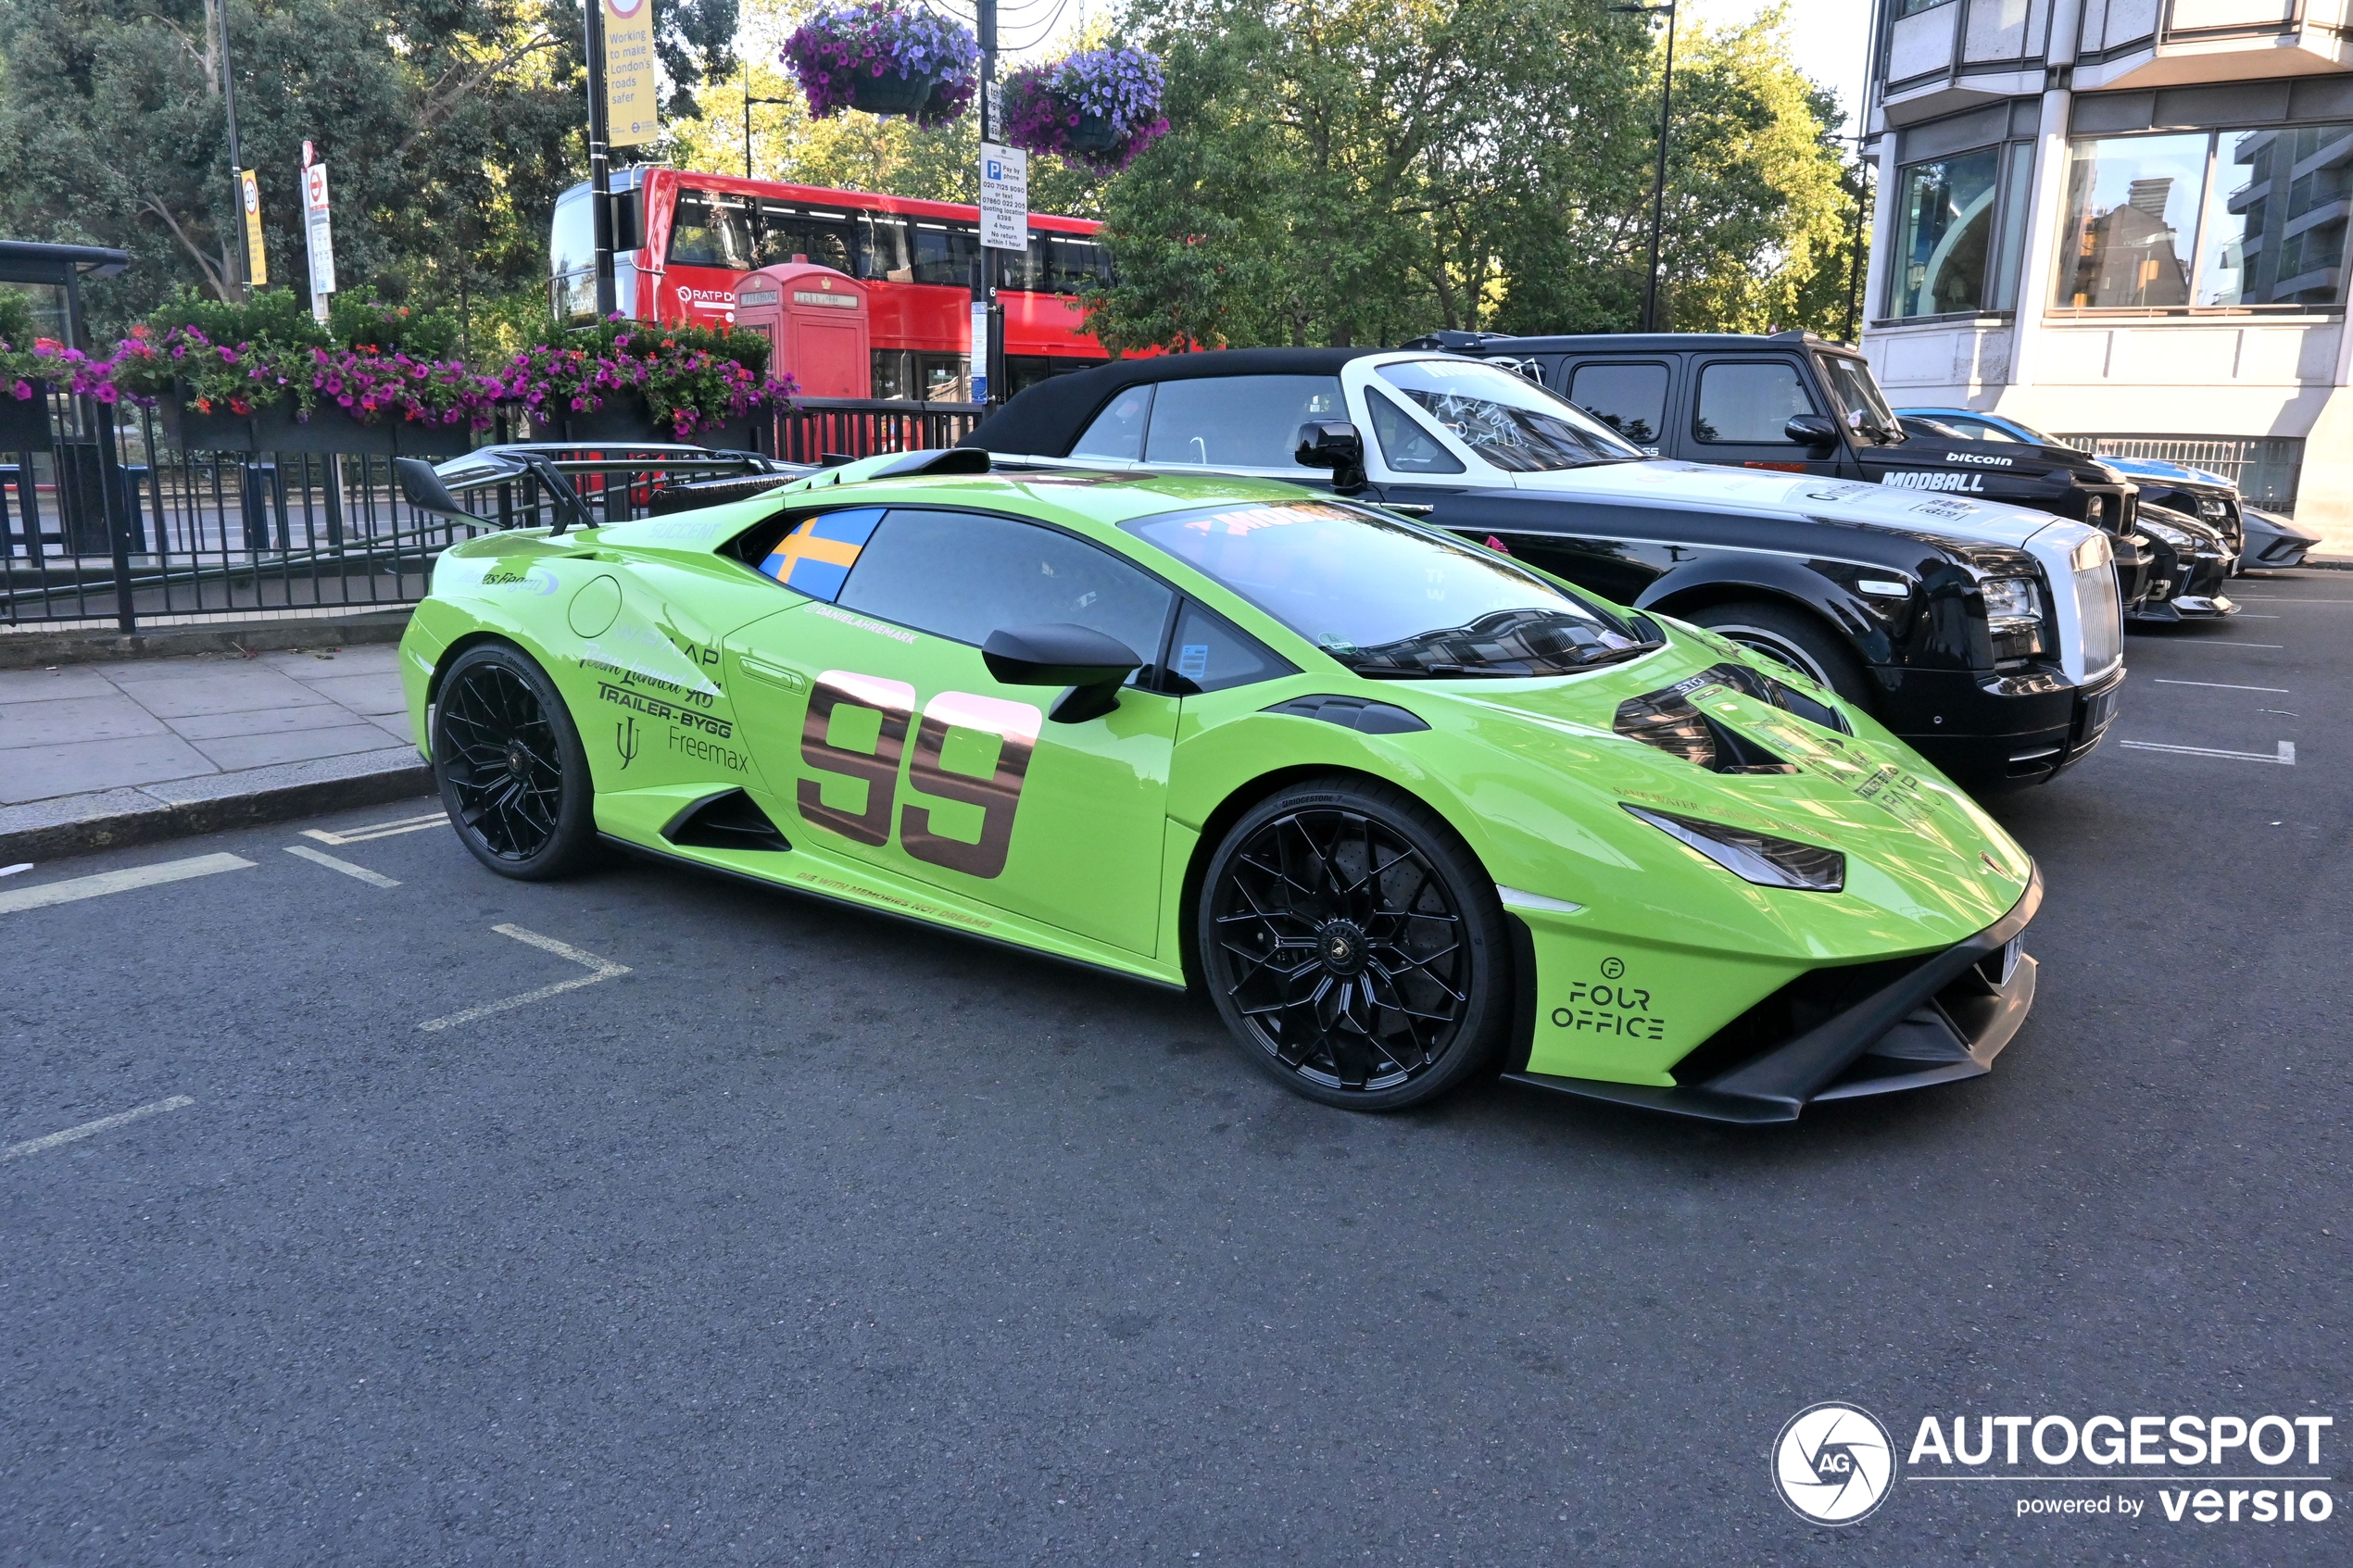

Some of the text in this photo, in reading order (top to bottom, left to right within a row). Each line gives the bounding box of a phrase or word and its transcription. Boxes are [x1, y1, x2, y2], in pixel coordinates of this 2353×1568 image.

[609, 29, 647, 44] Working
[610, 45, 647, 60] to make
[610, 58, 651, 75] London's
[611, 76, 636, 90] roads
[611, 92, 635, 105] safer
[990, 162, 1000, 177] P
[1002, 165, 1013, 173] Pay
[996, 182, 1009, 191] 7125
[245, 189, 255, 204] 20
[982, 196, 1000, 206] 07860
[1014, 201, 1026, 209] 205
[982, 205, 1025, 216] quoting location
[693, 289, 723, 301] RATP
[989, 287, 996, 296] 6
[1945, 452, 2013, 467] bitcoin
[710, 482, 736, 495] DRINK
[1881, 471, 1984, 492] MODBALL
[506, 656, 547, 699] BRIDGESTONE
[1676, 677, 1705, 693] STO
[598, 681, 734, 740] TRAILER-BYGG
[669, 725, 749, 774] Freemax
[797, 670, 1043, 880] 99
[1281, 795, 1334, 809] BRIDGESTONE
[796, 872, 993, 929] DIE WITH MEMORIES NOT DREAMS
[1569, 982, 1651, 1011] FOUR
[1551, 1008, 1665, 1040] OFFICE
